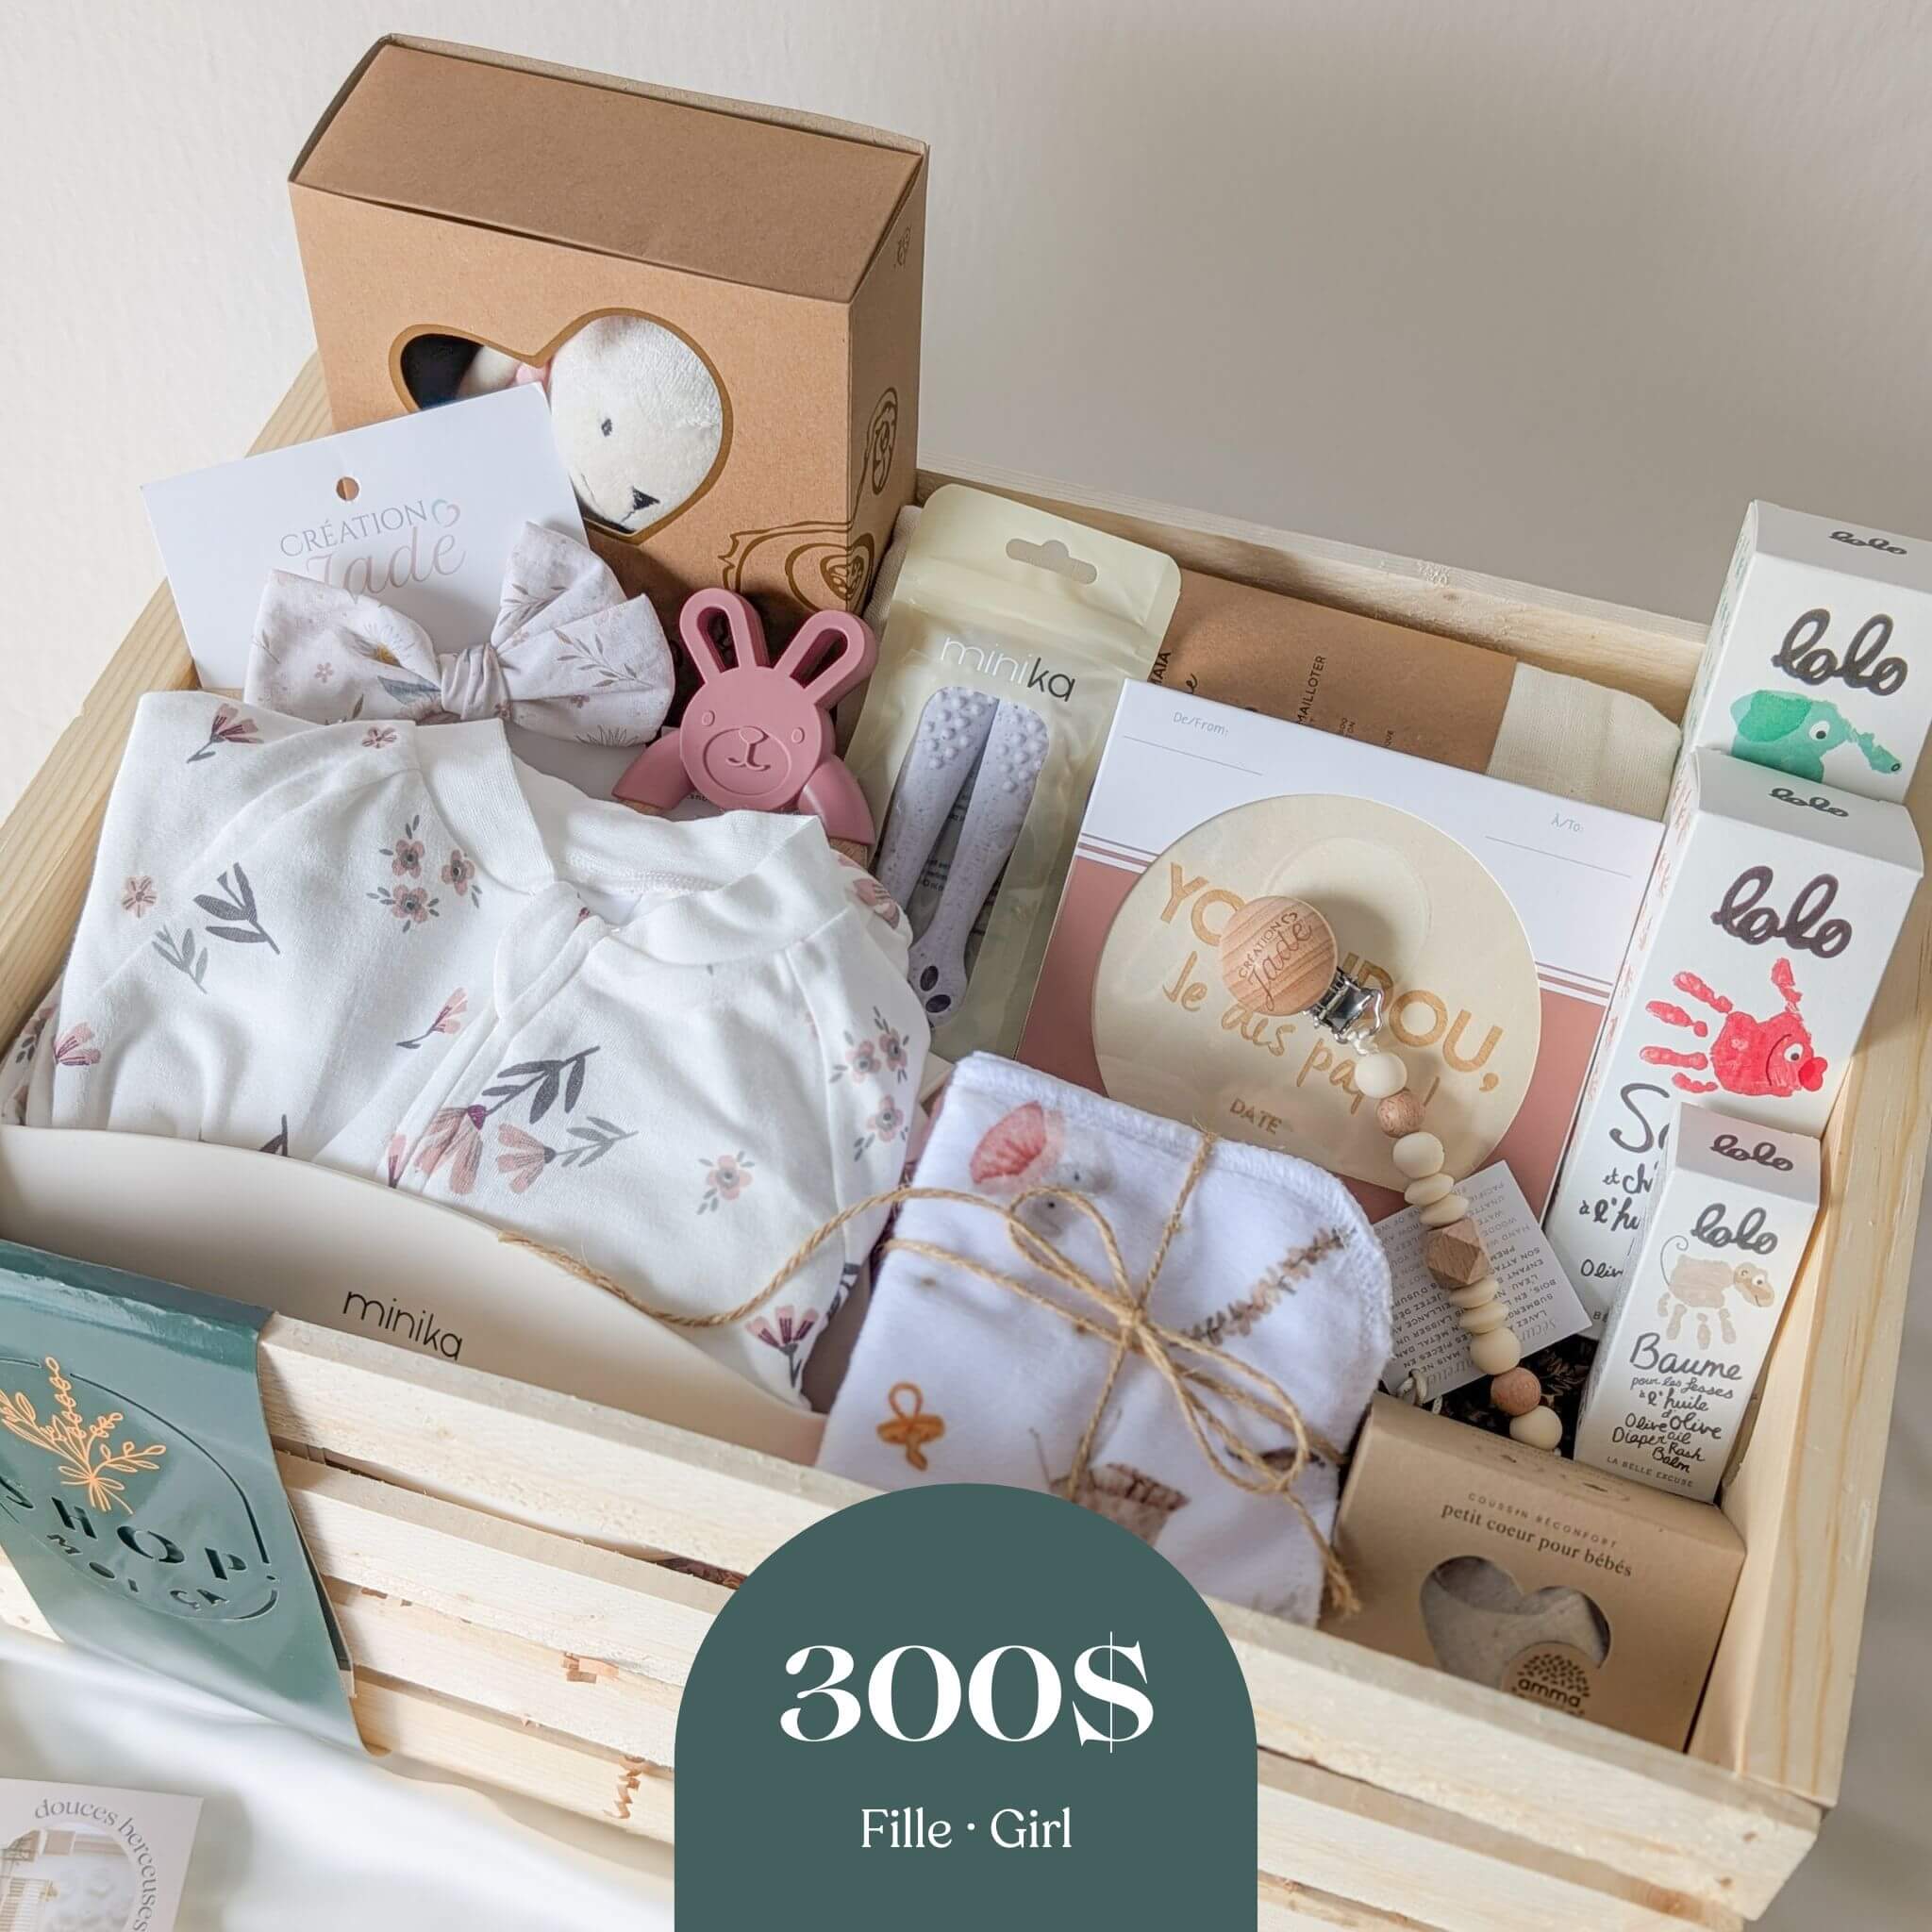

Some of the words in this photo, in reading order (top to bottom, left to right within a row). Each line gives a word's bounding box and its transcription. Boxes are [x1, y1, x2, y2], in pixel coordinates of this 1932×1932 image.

[280, 500, 427, 557] CRÉATION
[1828, 531, 1907, 555] lolo
[940, 635, 1075, 703] minika
[1771, 608, 1907, 696] lolo
[1297, 656, 1325, 724] MAILLOTER
[1769, 787, 1849, 818] lolo
[1711, 866, 1853, 958] lolo
[1248, 923, 1312, 1011] Jade
[1229, 1098, 1283, 1135] DATE
[1709, 1134, 1793, 1171] lolo
[1690, 1203, 1778, 1255] lolo
[1580, 1258, 1624, 1279] Oliv
[341, 1291, 463, 1360] minika
[1629, 1332, 1742, 1380] Baume
[1630, 1377, 1660, 1391] pour
[1625, 1412, 1668, 1433] Olive
[1612, 1426, 1668, 1449] Diaper
[1669, 1441, 1706, 1462] Rash
[1652, 1446, 1690, 1474] Balm
[1441, 1504, 1483, 1527] petit
[1486, 1519, 1536, 1544] coeur
[1537, 1537, 1580, 1559] pour
[1584, 1548, 1633, 1577] bébés
[1468, 1491, 1529, 1520] COUSSIN
[1536, 1515, 1618, 1549] RÉCONFORT
[1518, 1678, 1582, 1708] amma
[35, 1799, 119, 1827] douces
